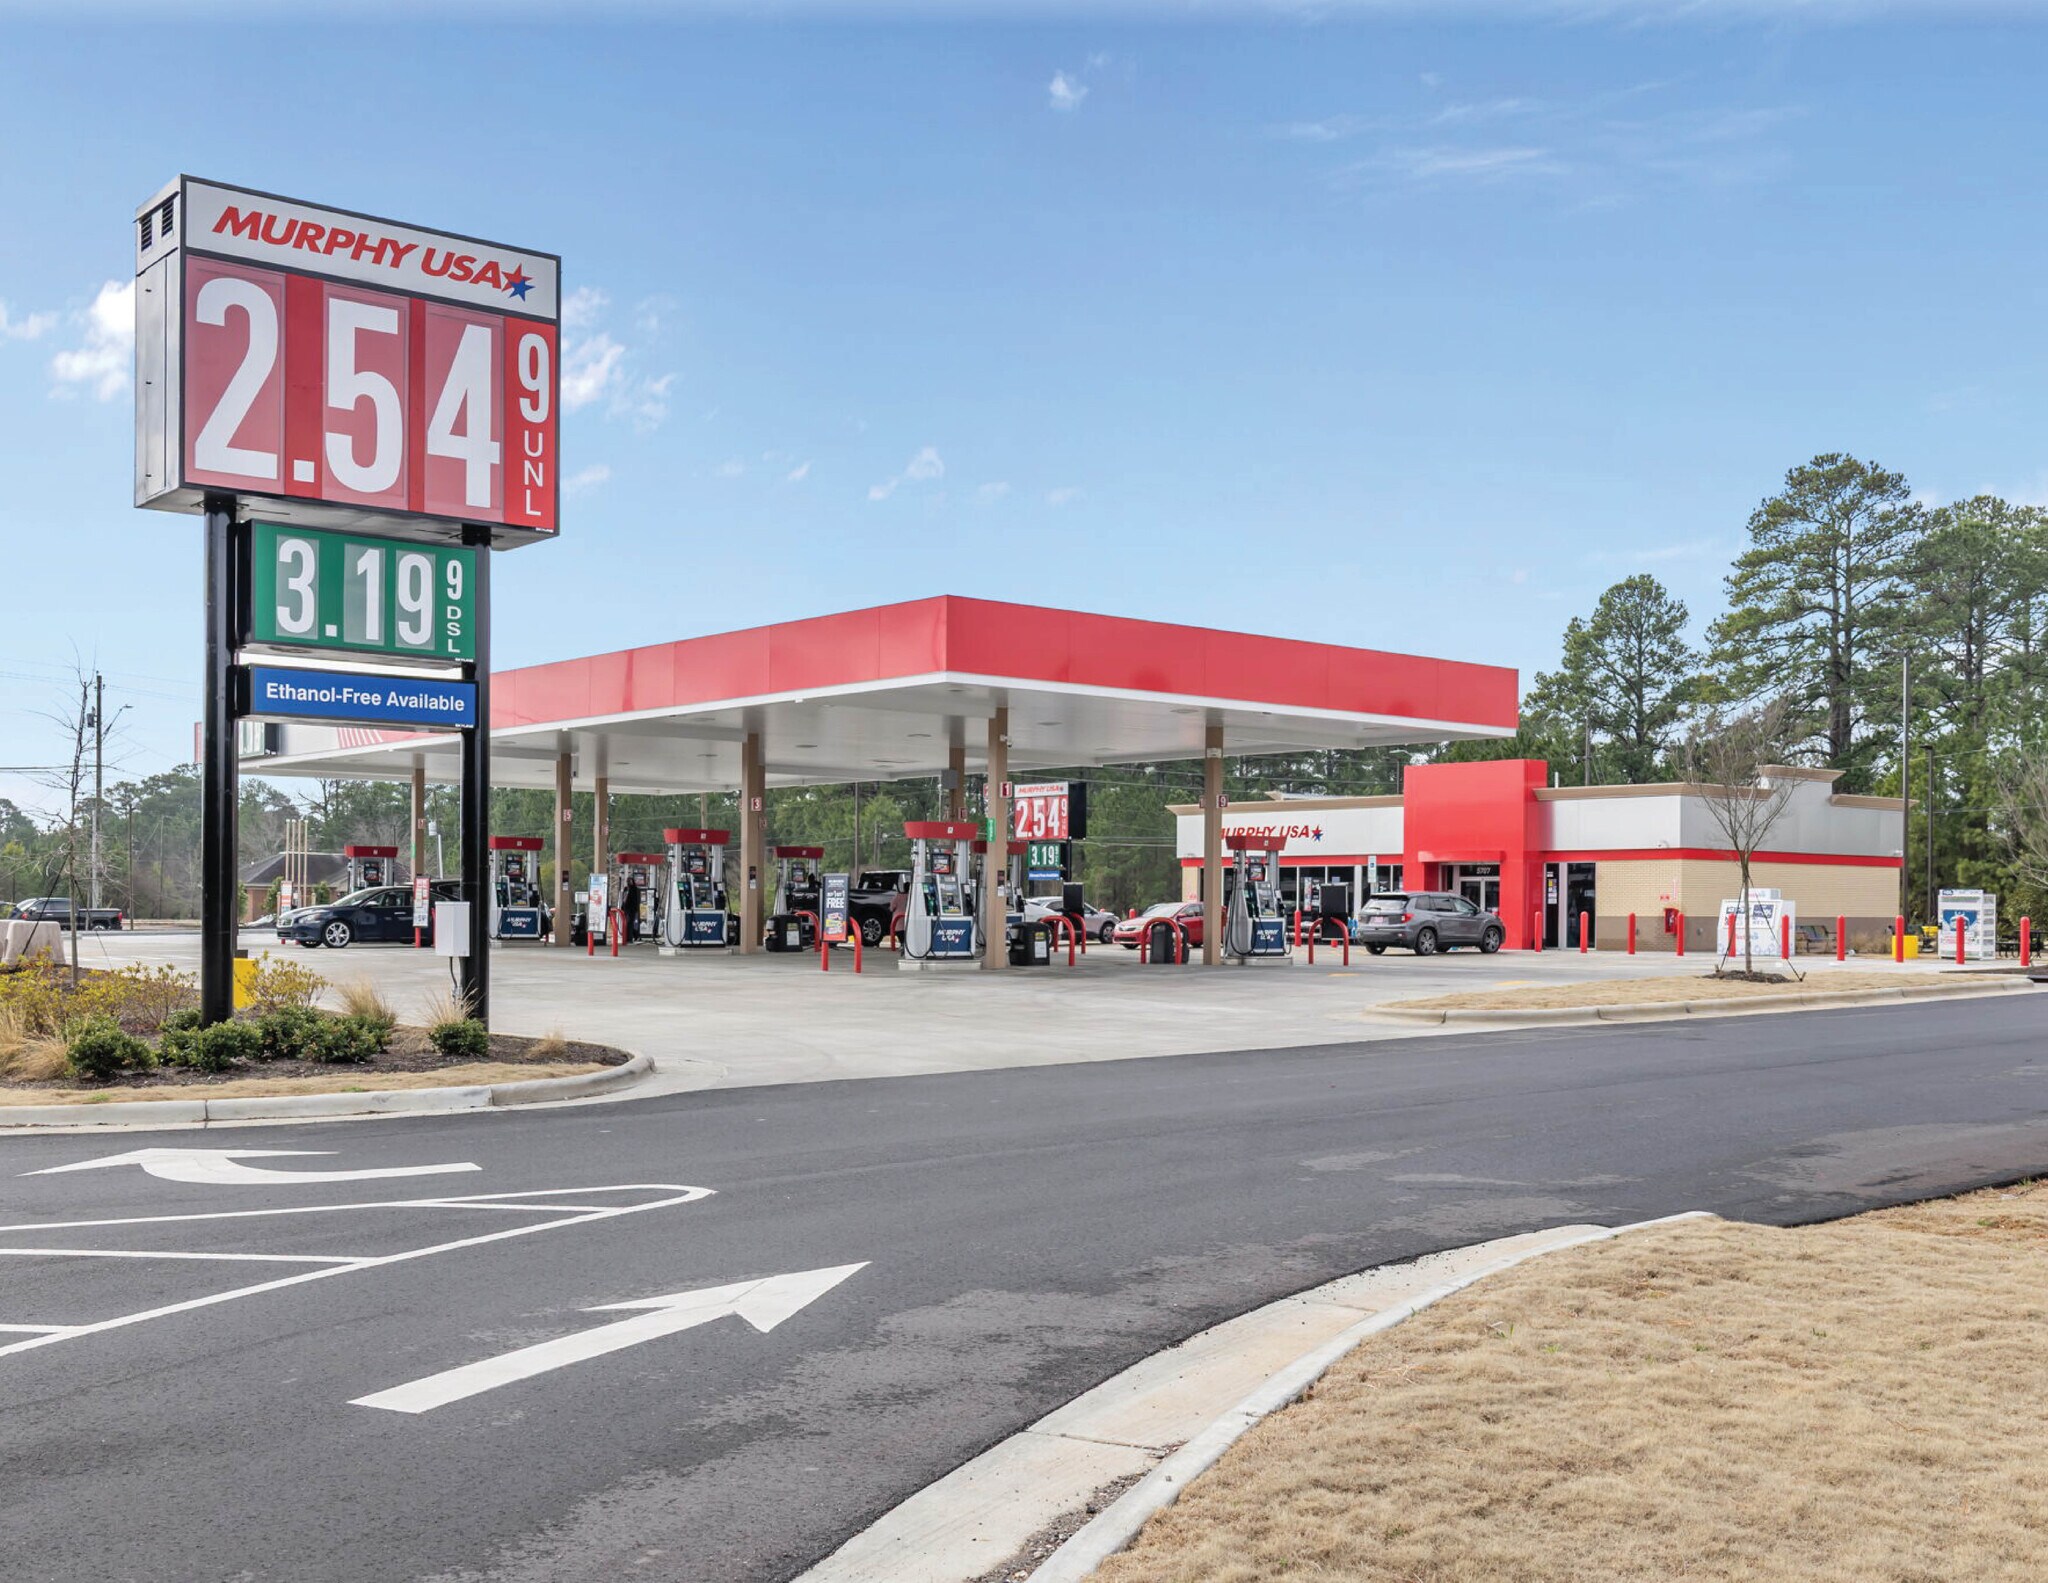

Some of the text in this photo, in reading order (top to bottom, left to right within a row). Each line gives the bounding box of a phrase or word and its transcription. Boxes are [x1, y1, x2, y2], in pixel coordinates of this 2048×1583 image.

[212, 206, 502, 291] MURPHY USA
[194, 277, 550, 508] 2.54 9
[276, 538, 463, 646] 3.19 9
[266, 682, 465, 712] Ethanol-Free Available
[1016, 798, 1060, 838] 2.54
[1280, 825, 1310, 838] USA
[1031, 845, 1055, 865] 3.19
[826, 897, 845, 909] FREE
